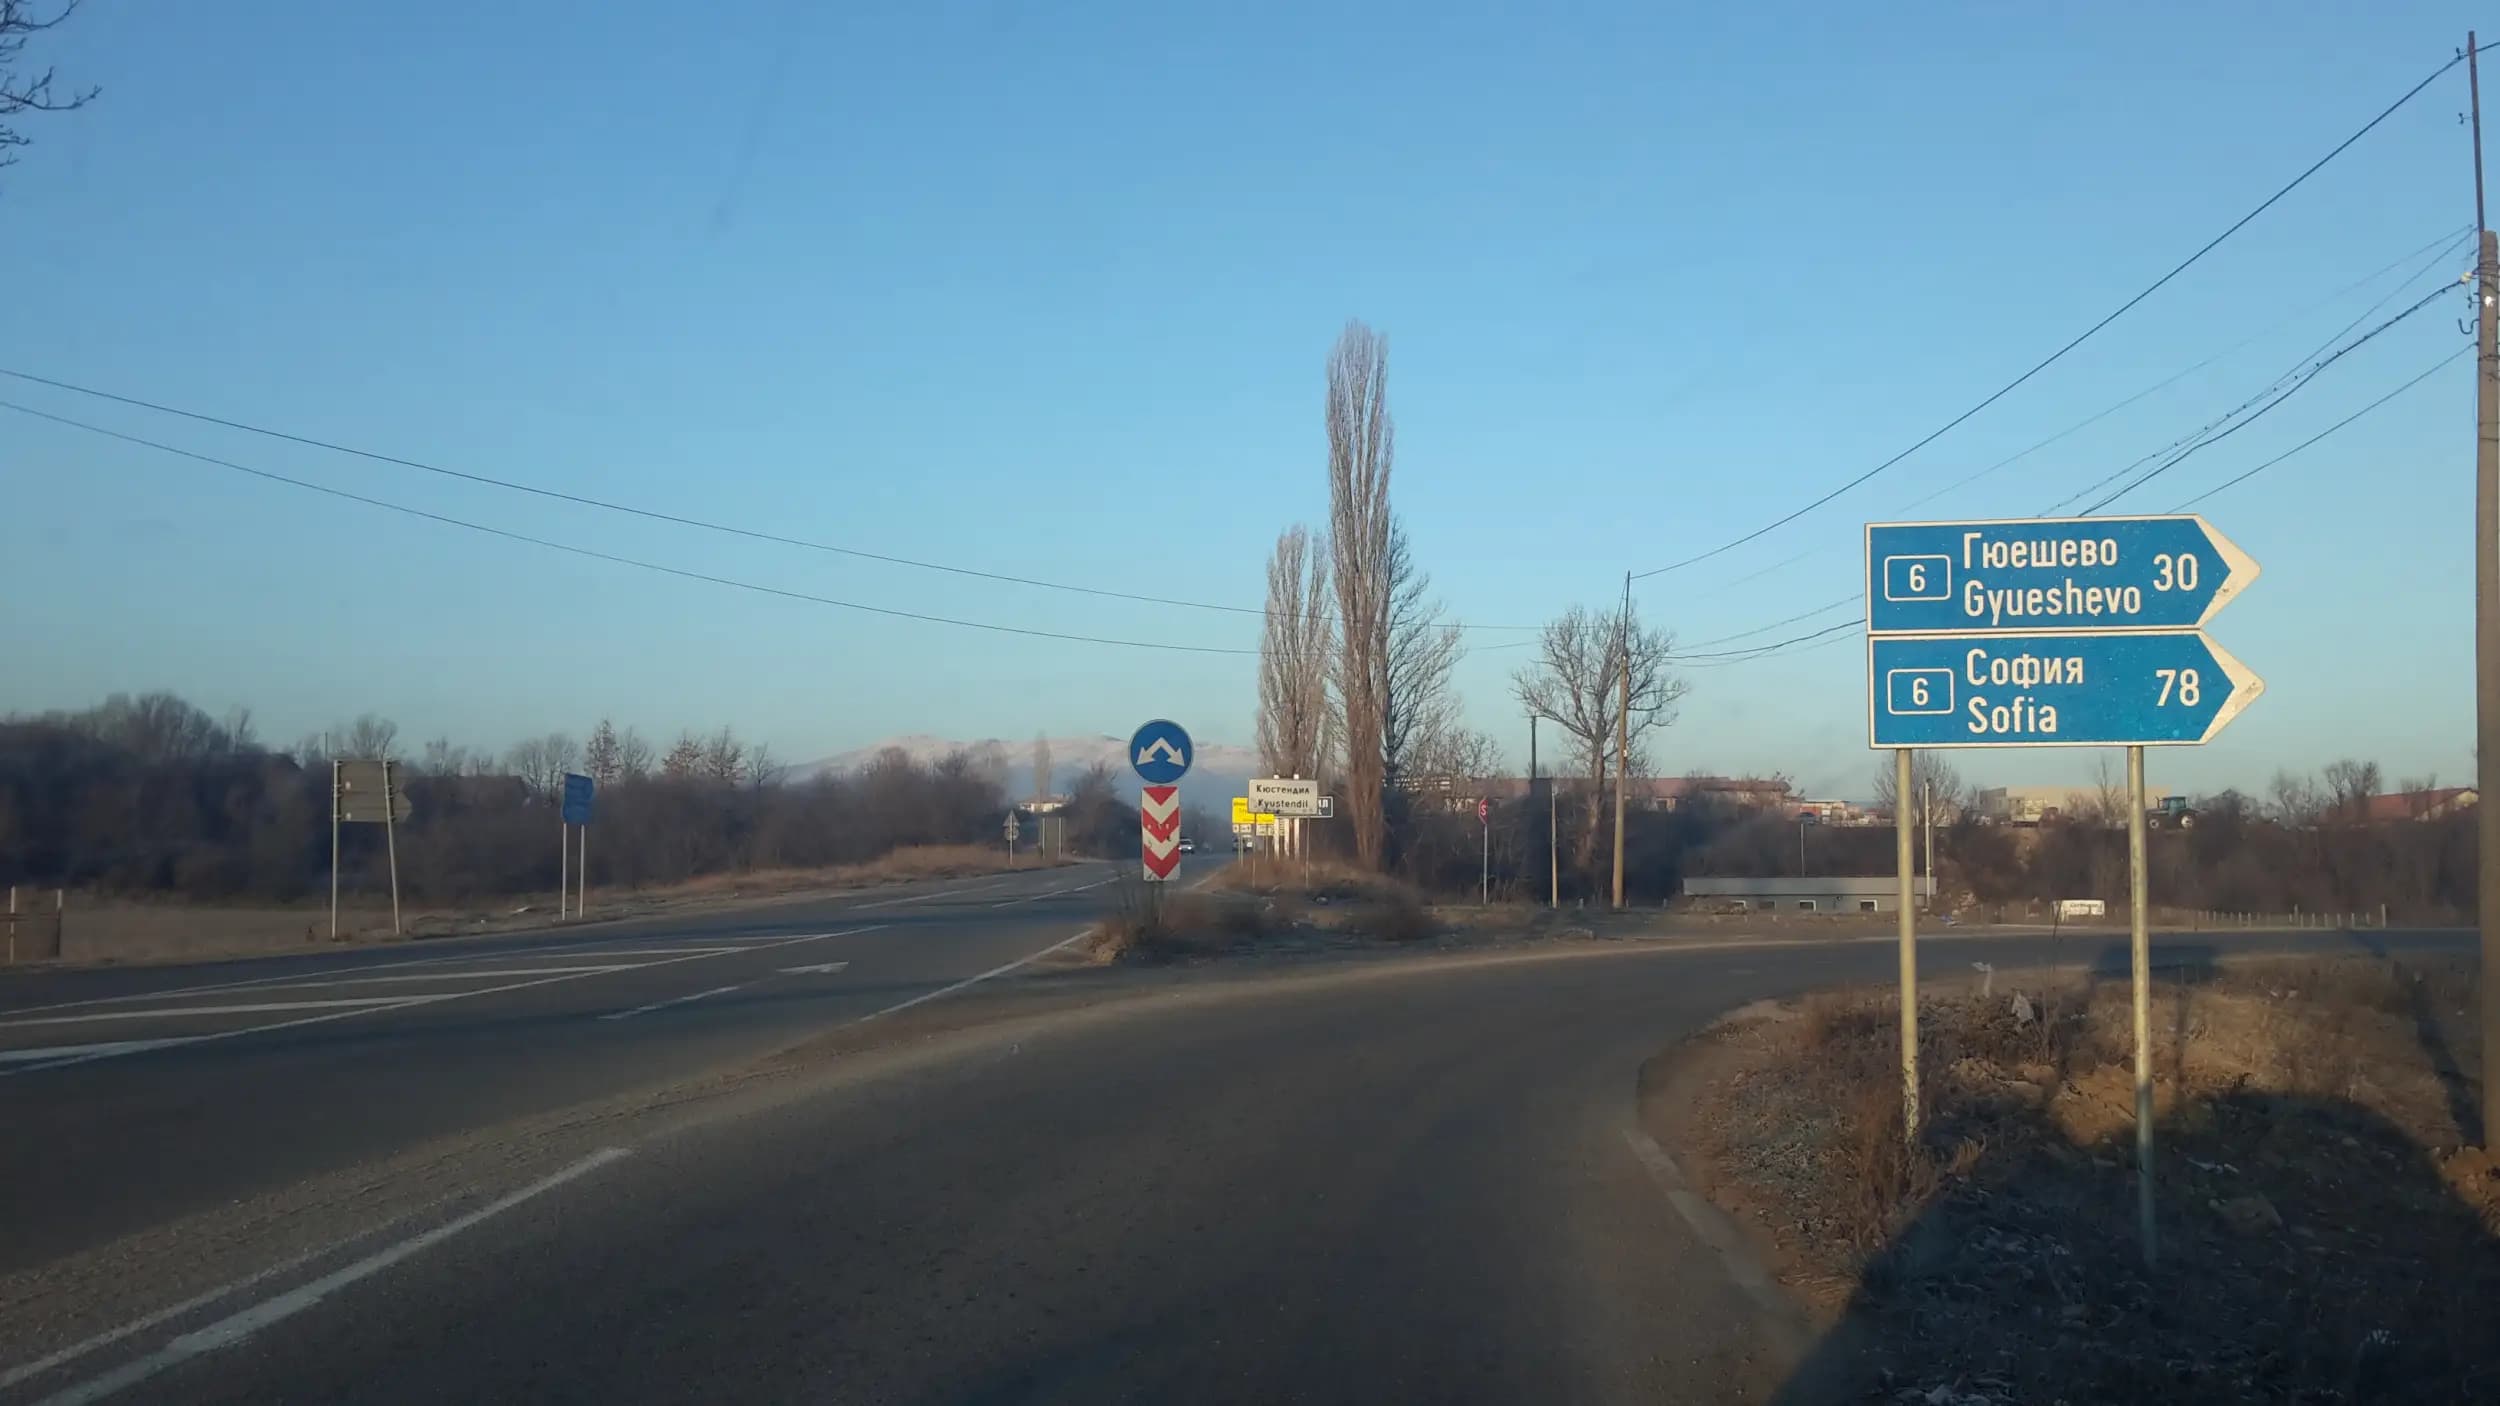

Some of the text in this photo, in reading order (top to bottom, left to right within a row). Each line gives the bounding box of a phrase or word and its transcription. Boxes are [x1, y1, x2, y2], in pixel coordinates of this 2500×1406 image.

[1963, 532, 2118, 569] Гюешево
[1908, 563, 1926, 592] 6
[2152, 553, 2198, 592] 30
[1964, 579, 2141, 626] Gyueshevo
[1966, 648, 2084, 689] София
[1911, 677, 1929, 706] 6
[2155, 669, 2200, 707] 78
[1967, 696, 2057, 734] Sofia
[1258, 799, 1308, 808] Kyustendil
